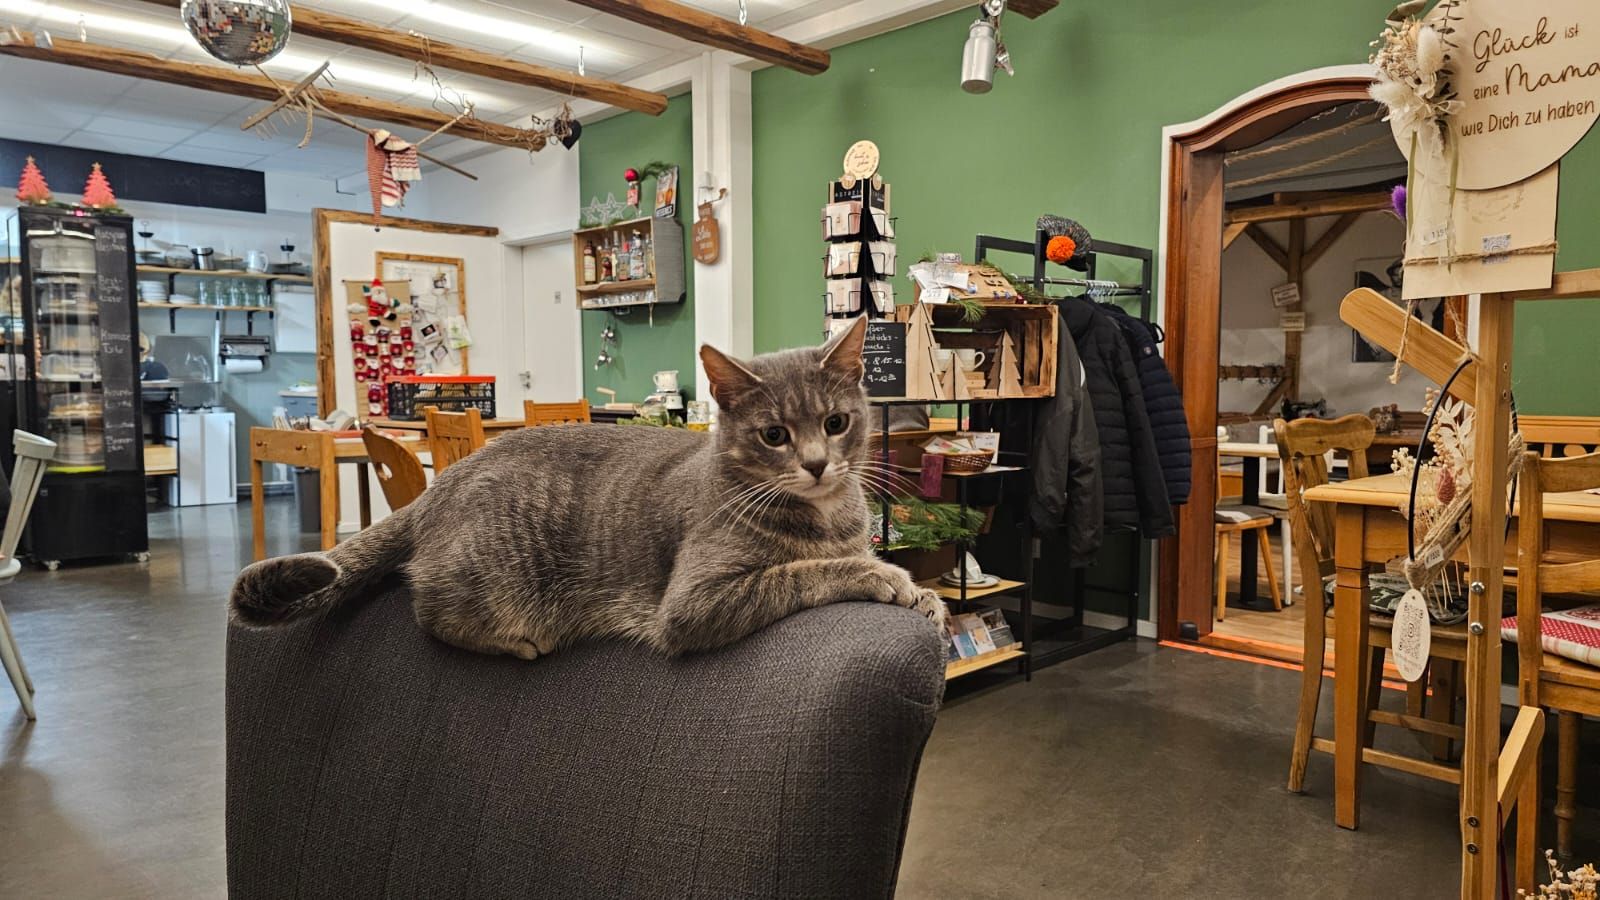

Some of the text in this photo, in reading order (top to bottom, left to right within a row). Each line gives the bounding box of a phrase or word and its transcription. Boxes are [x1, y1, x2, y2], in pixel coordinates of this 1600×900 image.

[1473, 16, 1580, 74] Glück ist
[1473, 63, 1600, 100] eine Mama
[1461, 99, 1595, 137] wie Dich zu haben
